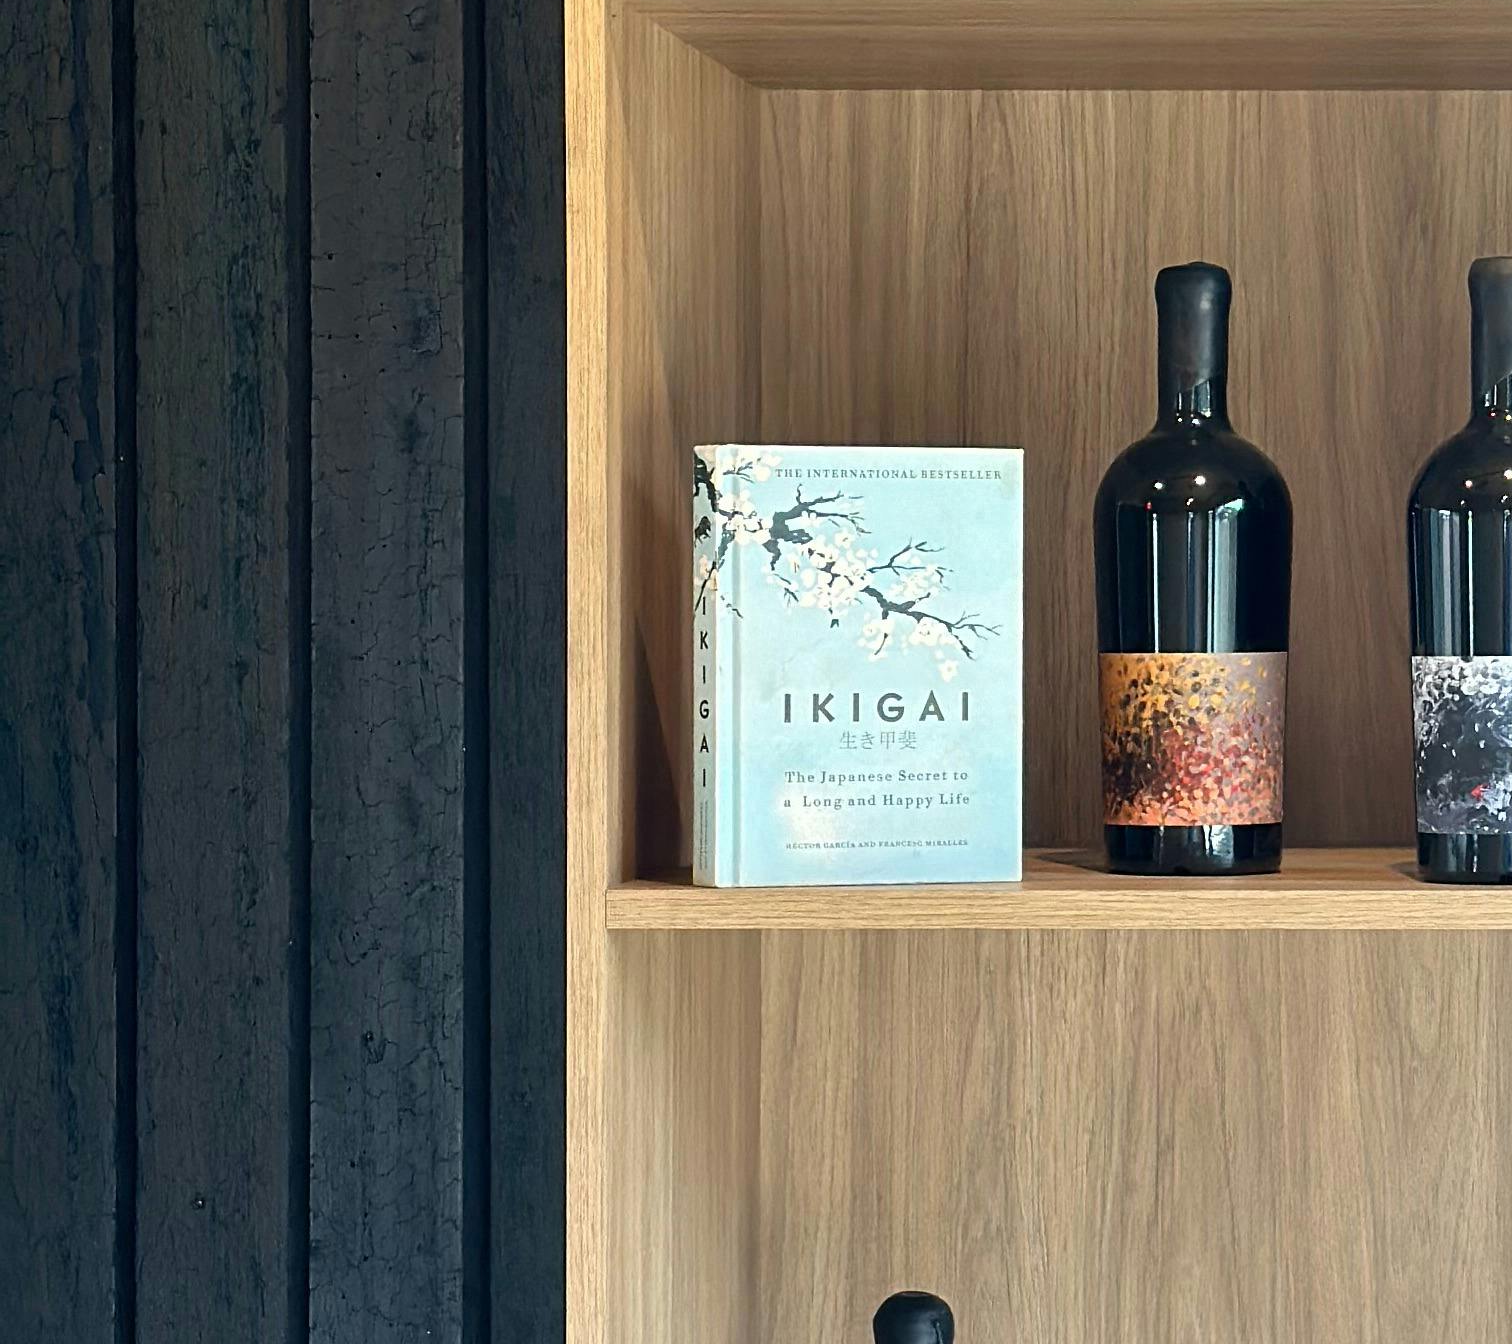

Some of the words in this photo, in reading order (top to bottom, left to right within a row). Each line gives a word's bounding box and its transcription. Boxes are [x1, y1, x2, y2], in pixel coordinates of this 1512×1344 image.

[775, 468, 802, 478] THE
[807, 468, 917, 479] INTERNATIONAL
[921, 469, 1002, 480] BESTSELLER
[699, 596, 710, 788] IKIGAI
[784, 690, 969, 723] IKIGAI
[840, 730, 917, 750] 生き甲斐
[785, 771, 815, 783] The
[820, 771, 893, 786] Japanese
[898, 770, 948, 782] Secret
[953, 771, 968, 781] to
[783, 799, 791, 808] a
[803, 796, 842, 810] Long
[847, 795, 876, 806] and
[882, 794, 933, 809] Happy
[939, 793, 970, 805] Life
[858, 840, 877, 848] AND
